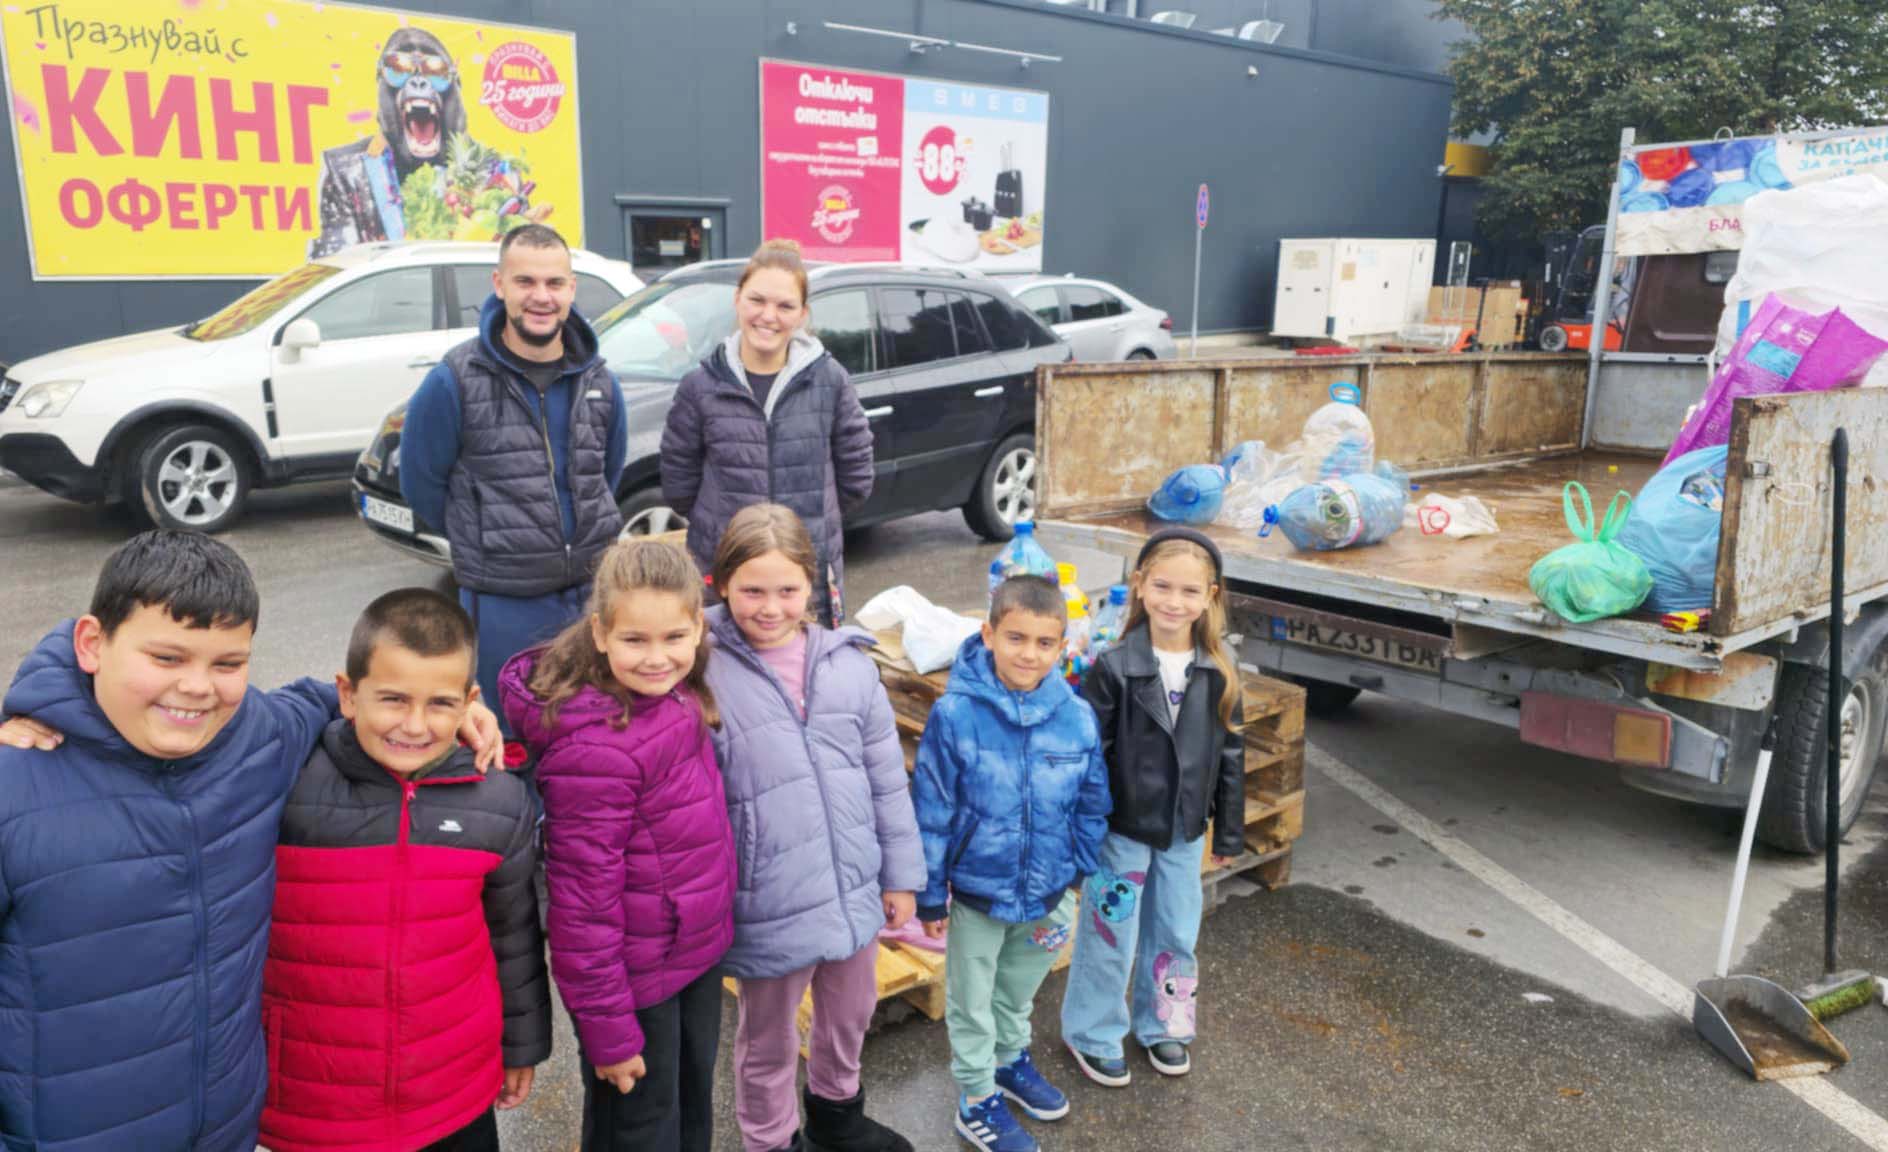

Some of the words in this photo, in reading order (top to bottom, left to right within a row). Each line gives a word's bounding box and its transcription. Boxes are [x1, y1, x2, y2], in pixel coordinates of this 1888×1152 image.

[26, 4, 221, 64] Празнувай
[231, 38, 249, 57] с
[41, 63, 329, 164] КИНГ
[480, 80, 507, 104] 25
[1803, 134, 1888, 156] КАПАЧ
[58, 178, 312, 231] ОФЕРТИ
